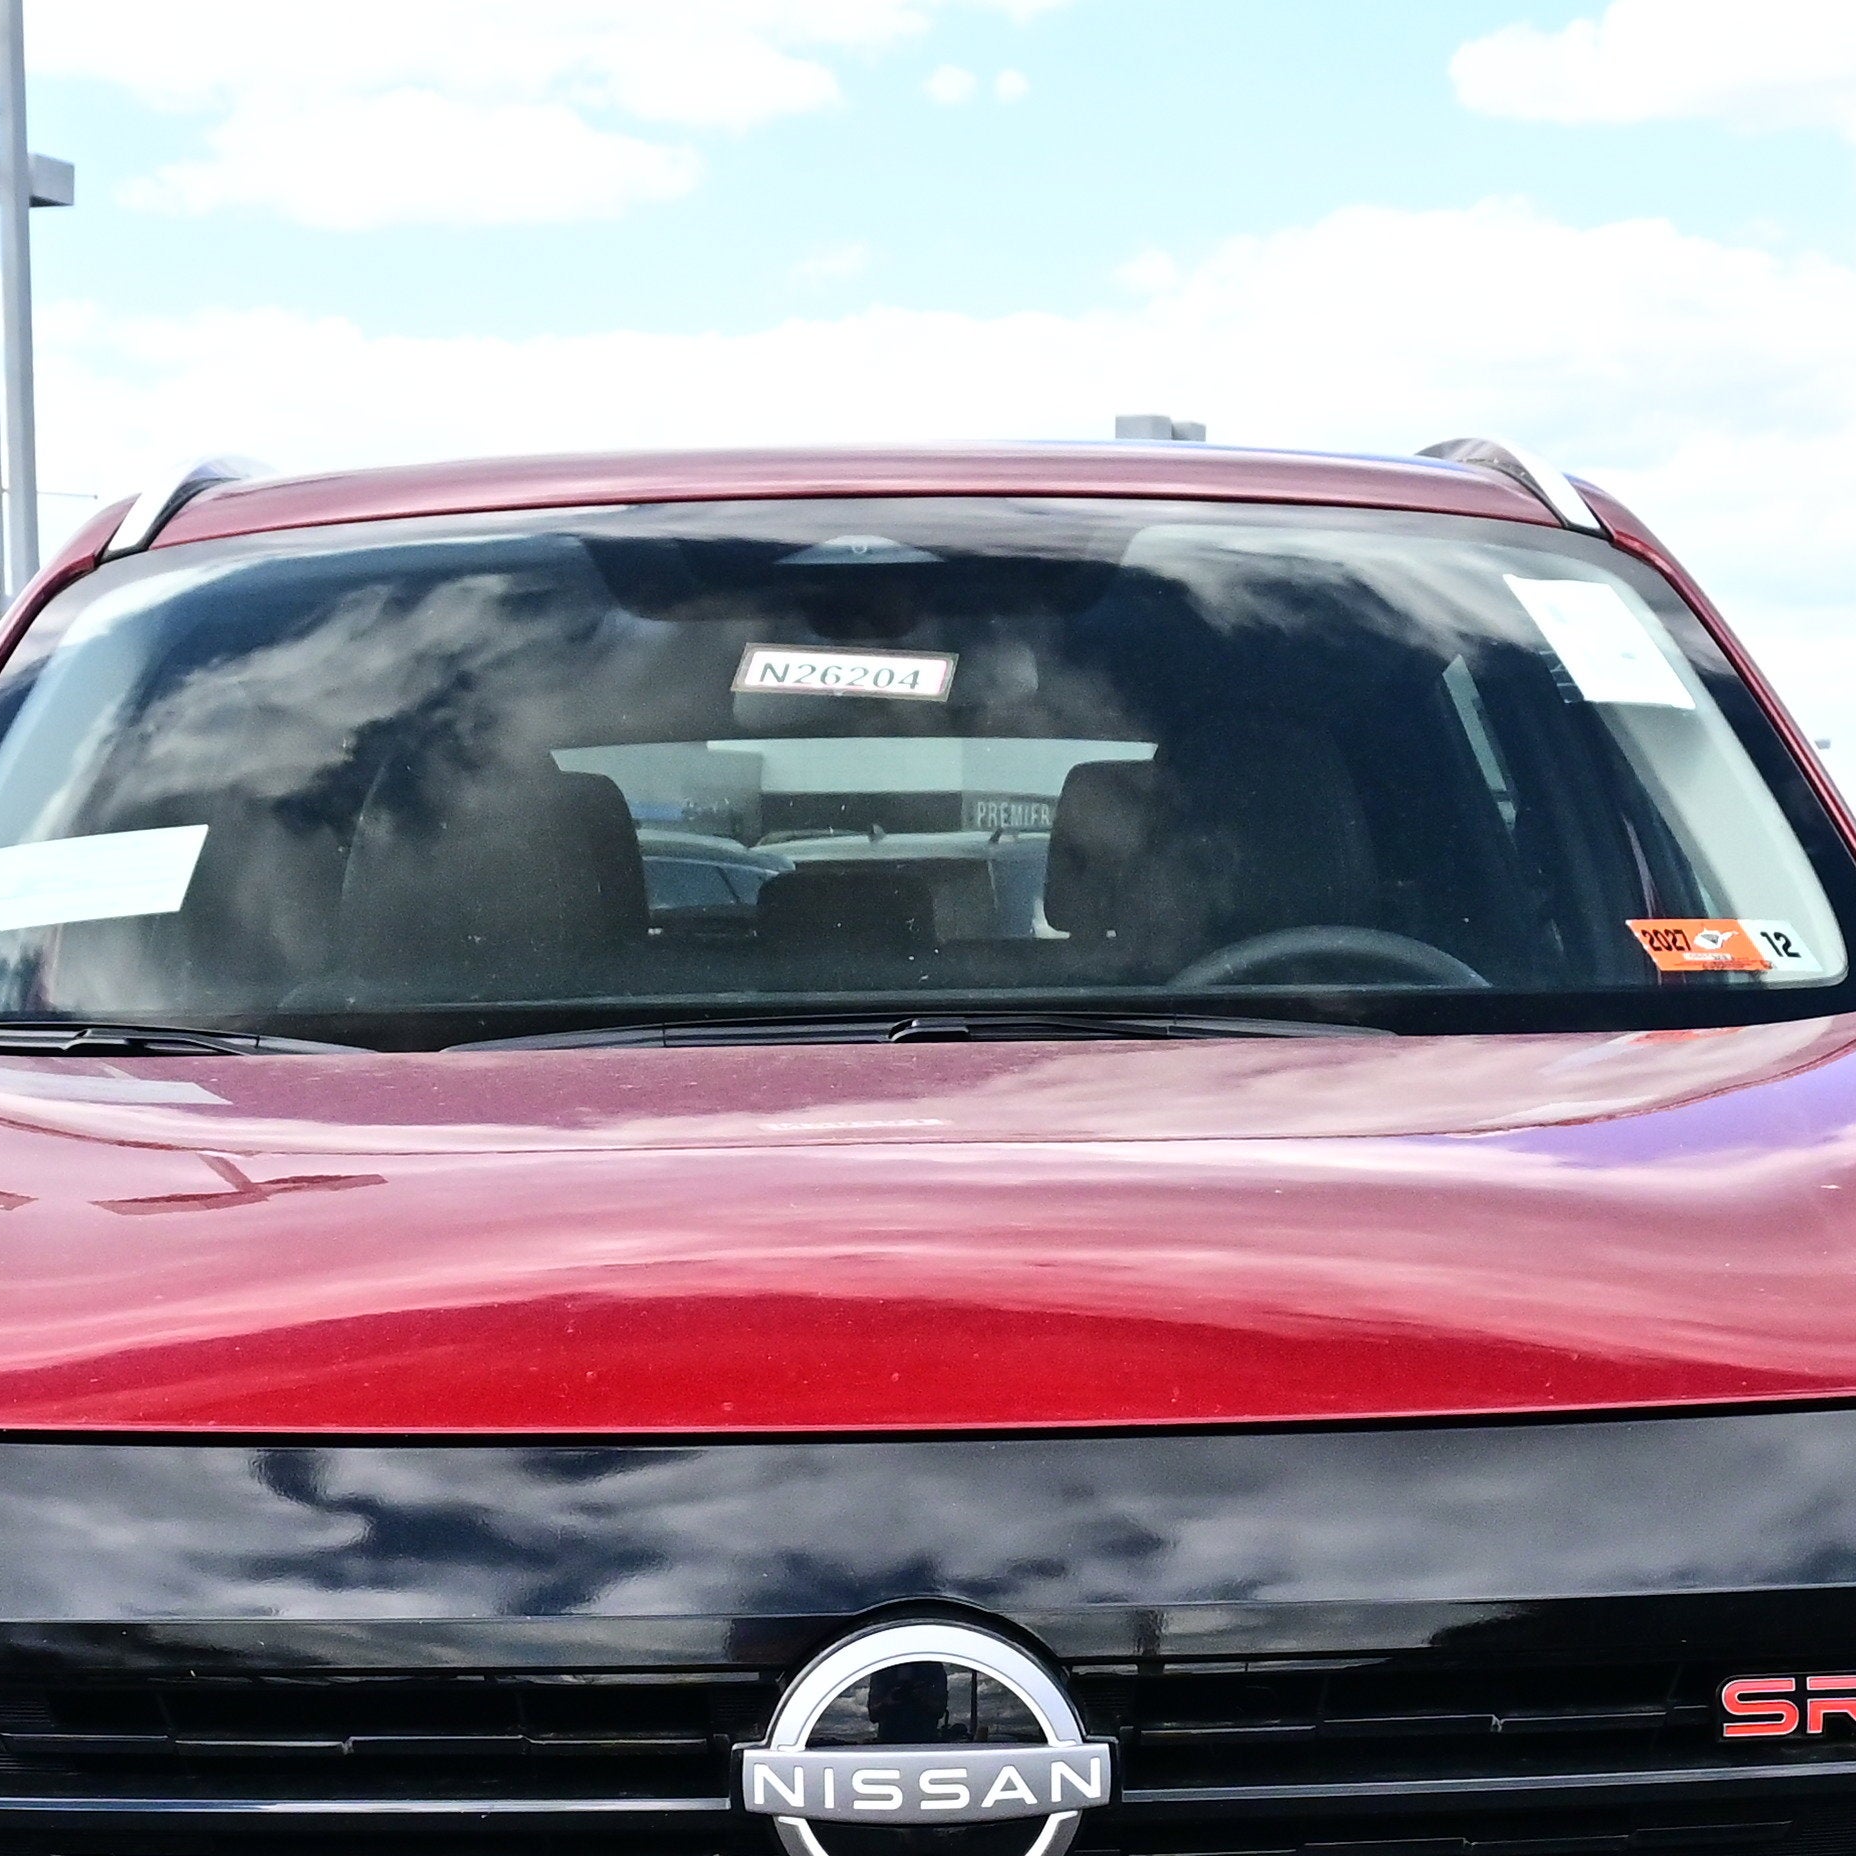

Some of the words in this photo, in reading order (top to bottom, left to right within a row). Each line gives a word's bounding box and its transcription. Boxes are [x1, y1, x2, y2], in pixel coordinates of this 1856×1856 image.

[758, 661, 921, 690] N26204
[1640, 928, 1692, 952] 2027
[1759, 931, 1802, 959] 12
[753, 1756, 1102, 1811] NISSAN
